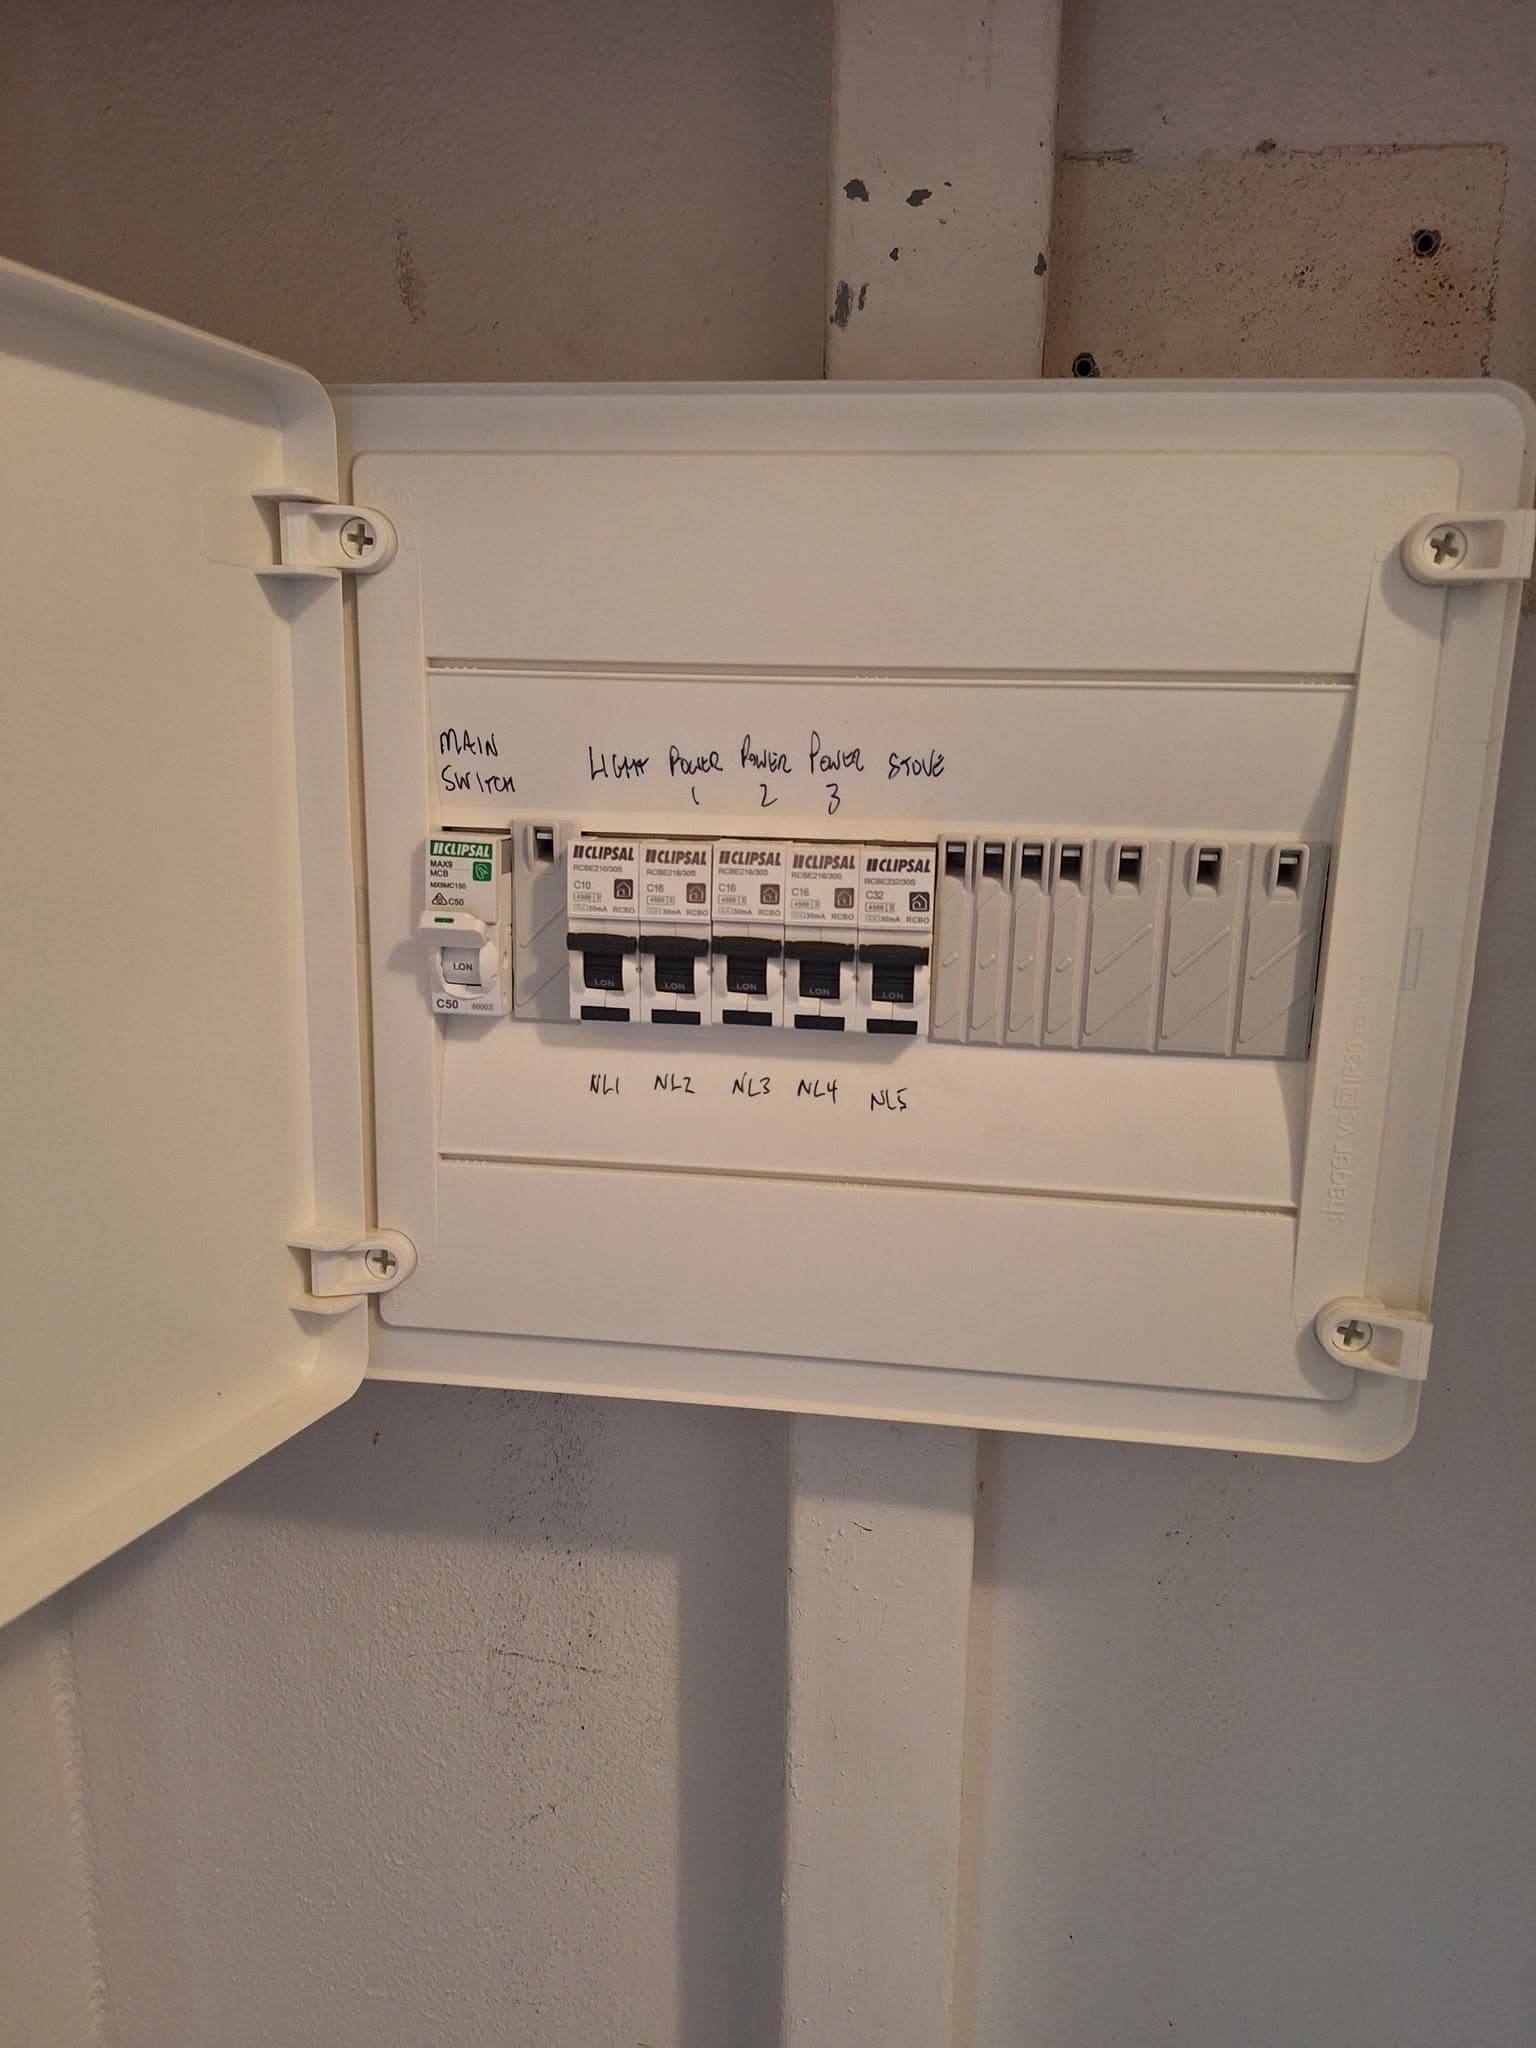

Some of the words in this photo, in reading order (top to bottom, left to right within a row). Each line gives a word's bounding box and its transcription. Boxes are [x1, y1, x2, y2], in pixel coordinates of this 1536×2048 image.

[440, 728, 498, 757] MAIN
[888, 749, 945, 779] STOVE
[441, 764, 516, 794] SWITCH
[760, 783, 778, 807] 2
[826, 783, 841, 815] 3
[430, 860, 453, 868] MAX9
[430, 869, 449, 878] MCB
[573, 880, 591, 890] C10
[646, 884, 664, 893] C16
[718, 883, 736, 893] C16
[791, 887, 809, 897] C16
[865, 891, 884, 900] C32
[448, 898, 464, 906] C50
[436, 999, 459, 1010] C50
[589, 1073, 620, 1095] NL1
[654, 1073, 695, 1094] NL2
[732, 1072, 771, 1097] NL3
[797, 1079, 838, 1104] NL4
[870, 1087, 908, 1112] NL5
